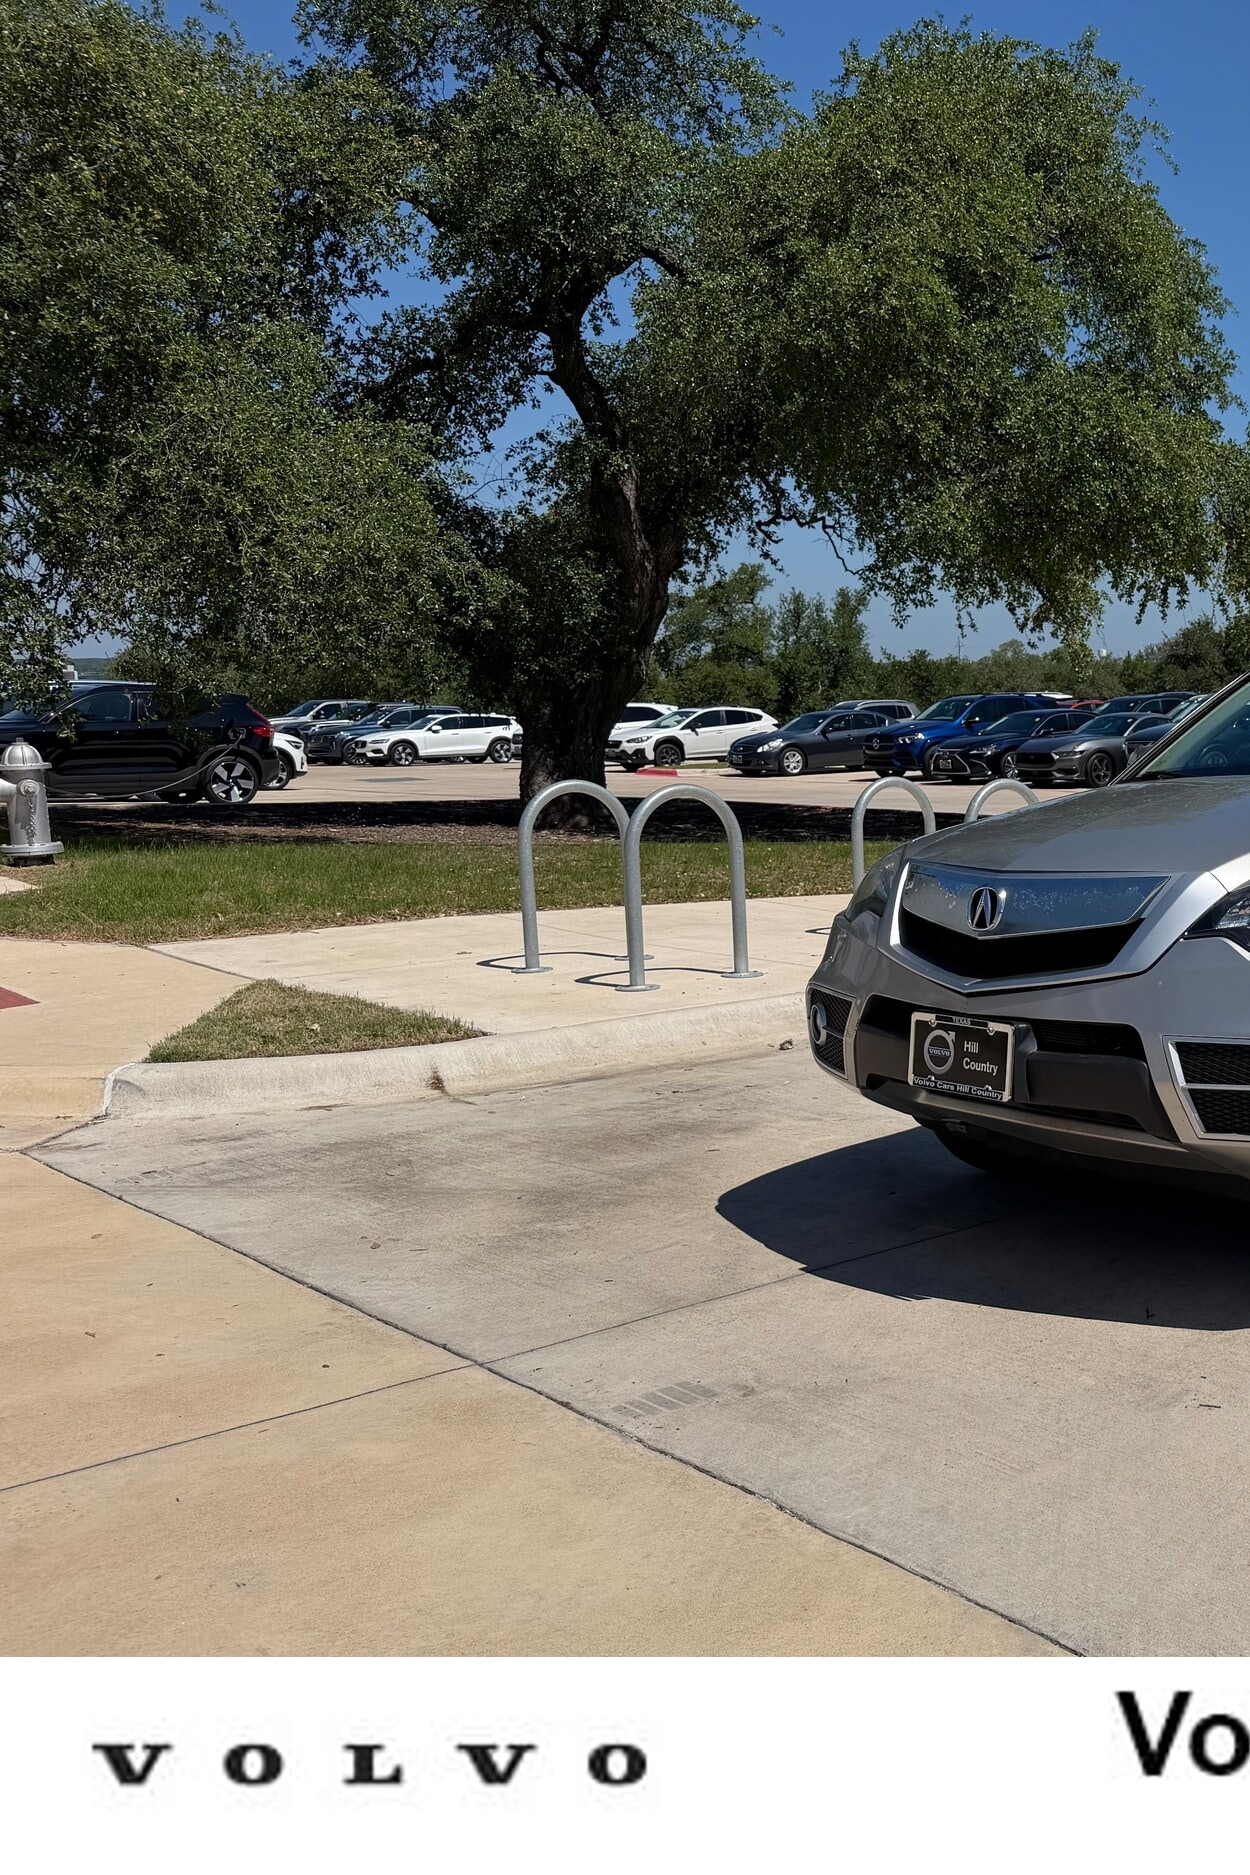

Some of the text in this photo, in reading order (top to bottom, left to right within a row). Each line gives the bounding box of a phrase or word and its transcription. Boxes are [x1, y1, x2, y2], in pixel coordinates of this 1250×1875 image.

[952, 1016, 971, 1026] TEXAS
[929, 1048, 950, 1057] VOLVO
[963, 1040, 979, 1054] Hill
[963, 1057, 999, 1076] Country
[914, 1078, 1002, 1100] Volvo Cars Hill Country
